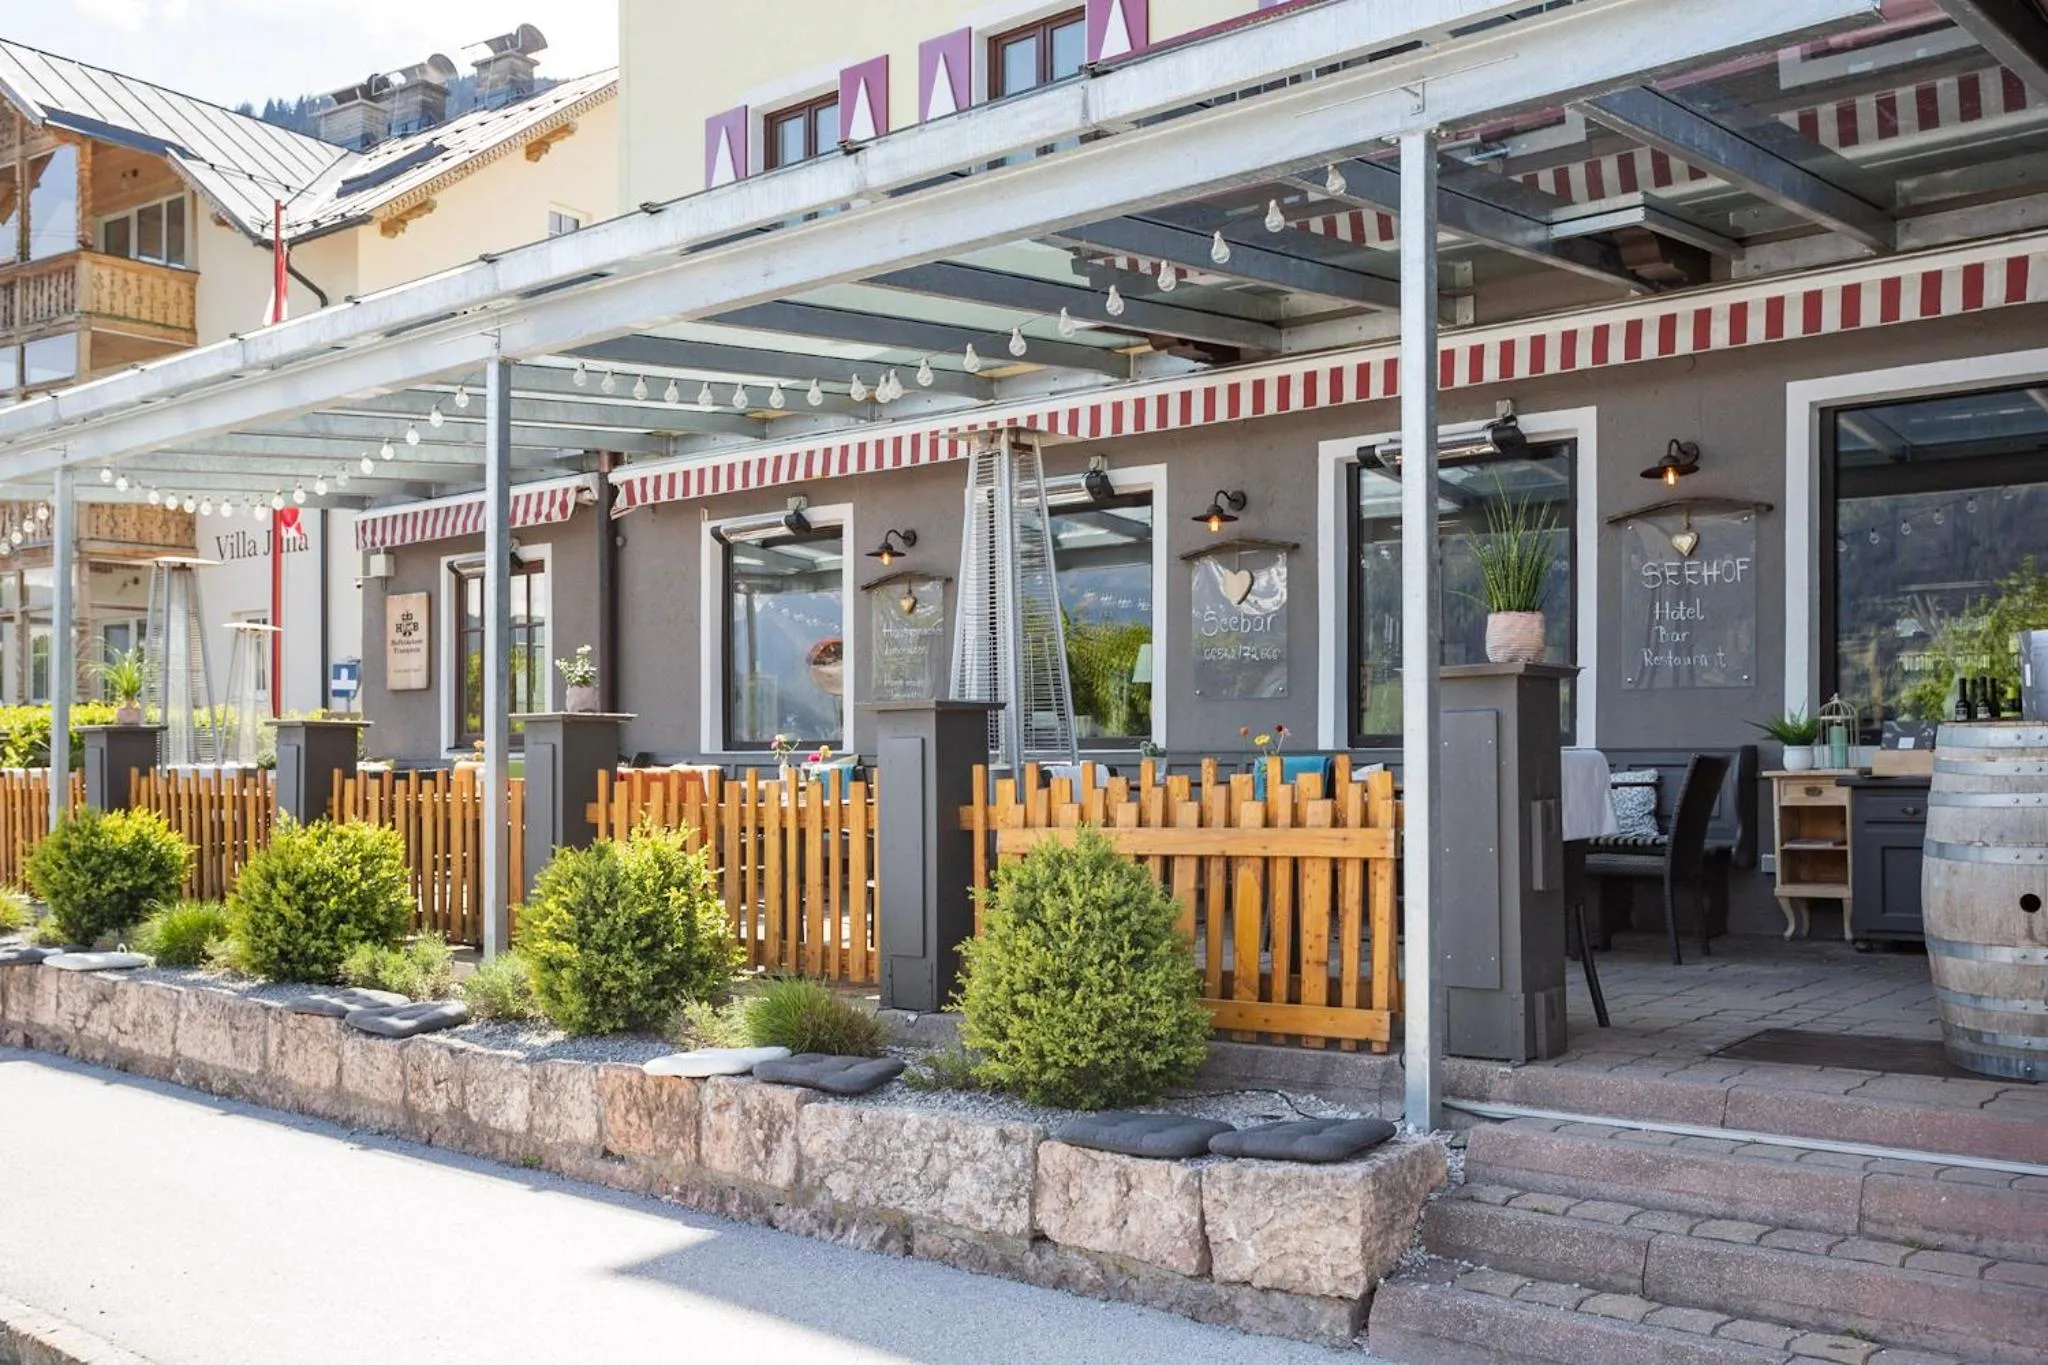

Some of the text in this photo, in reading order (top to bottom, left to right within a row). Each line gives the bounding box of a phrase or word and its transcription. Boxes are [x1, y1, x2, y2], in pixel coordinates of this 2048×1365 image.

[215, 530, 257, 560] Villa
[1641, 558, 1751, 589] SEEHOF
[1653, 598, 1705, 620] Hotel
[1201, 611, 1277, 637] Seebar
[1653, 625, 1690, 643] Bar
